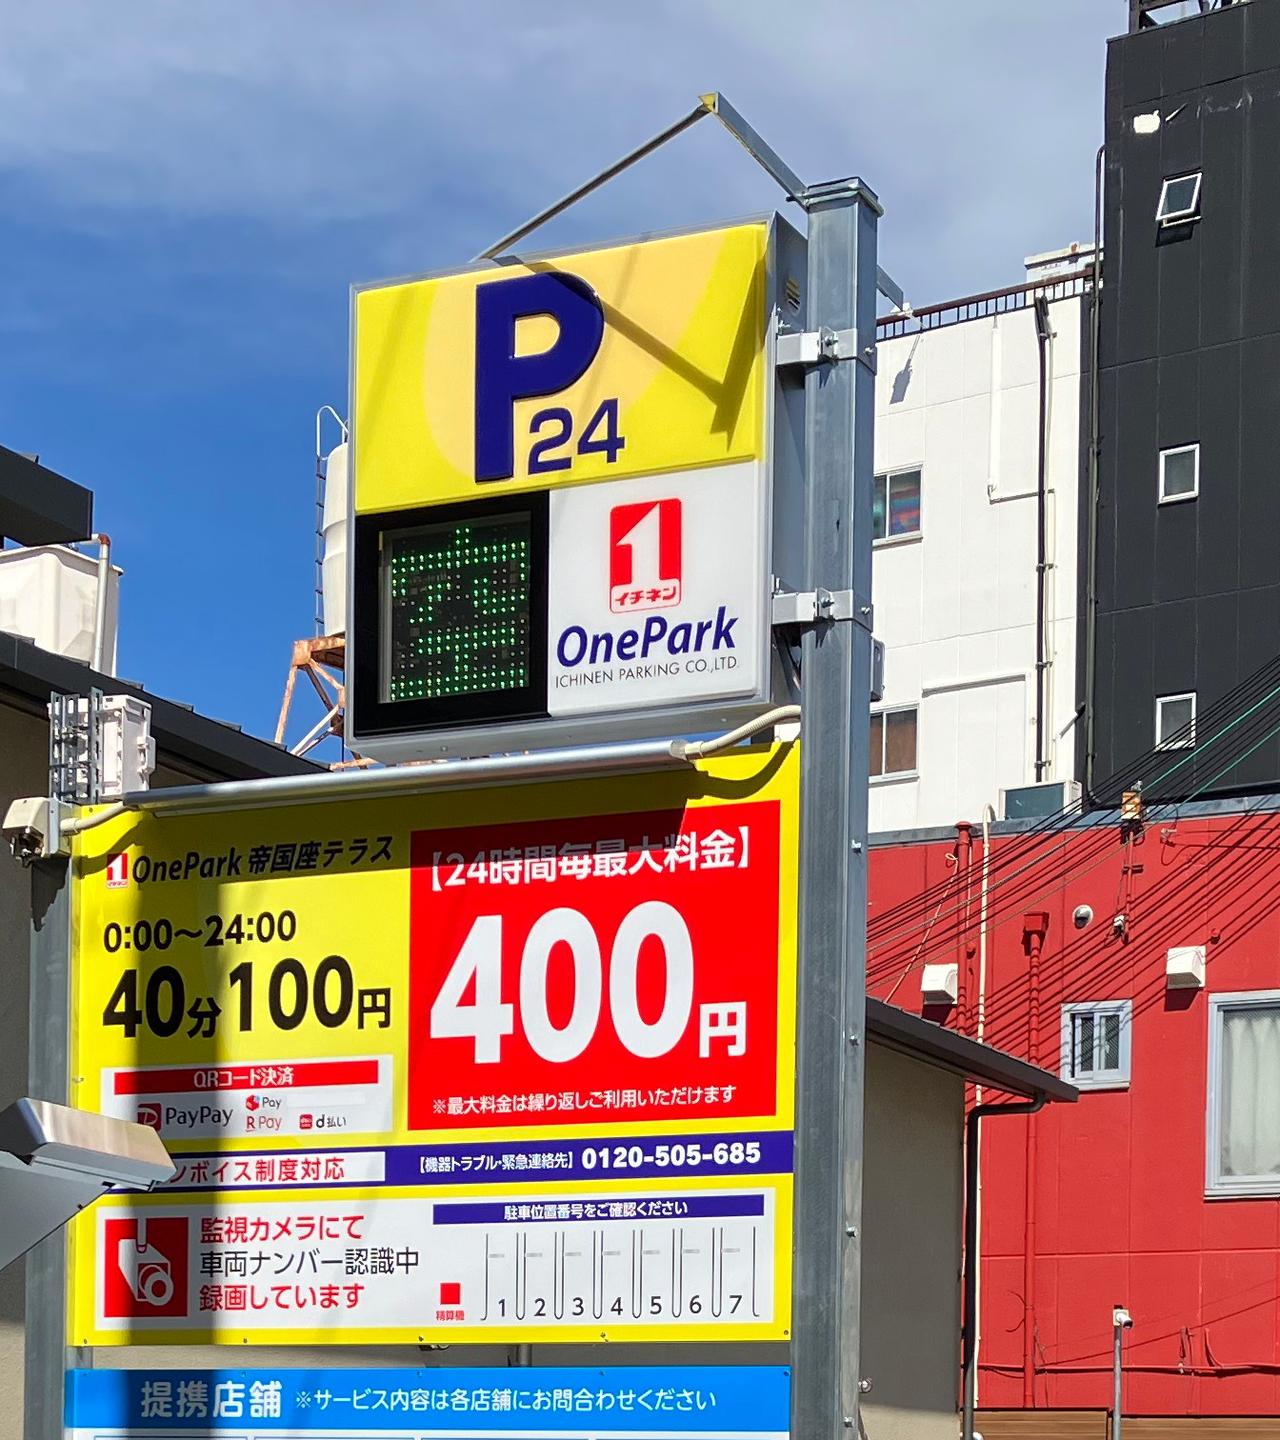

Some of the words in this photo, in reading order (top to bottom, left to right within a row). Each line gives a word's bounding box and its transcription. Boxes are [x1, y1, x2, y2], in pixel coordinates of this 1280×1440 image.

[475, 271, 605, 483] P
[527, 398, 625, 475] 24
[615, 586, 676, 606] イチネン
[391, 527, 526, 700] 空
[557, 606, 739, 667] OnePark
[555, 670, 613, 688] ICHINEN
[619, 662, 680, 680] PARKING
[132, 847, 241, 884] OnePark
[248, 836, 393, 874] 帝国座テラス
[429, 900, 747, 1064] 400円
[194, 1067, 294, 1088] QRコード決済
[262, 1096, 282, 1110] Pay
[165, 1107, 233, 1128] PayPay
[258, 1115, 282, 1131] Pay
[581, 1141, 761, 1169] 0120-505-685
[504, 1201, 688, 1220] 駐車位置番号をご確認ください
[200, 1215, 365, 1244] 監視カメラにて
[200, 1246, 419, 1277] 車両ナンバー認識中
[200, 1283, 365, 1311] 録画しています
[498, 1299, 507, 1316] 1
[534, 1298, 546, 1316] 2
[572, 1297, 585, 1316] 3
[611, 1297, 623, 1316] 4
[650, 1296, 662, 1315] 5
[689, 1295, 702, 1314] 6
[730, 1294, 742, 1314] 7
[435, 1310, 465, 1321] 精算機
[140, 1380, 283, 1418] 提携店舗
